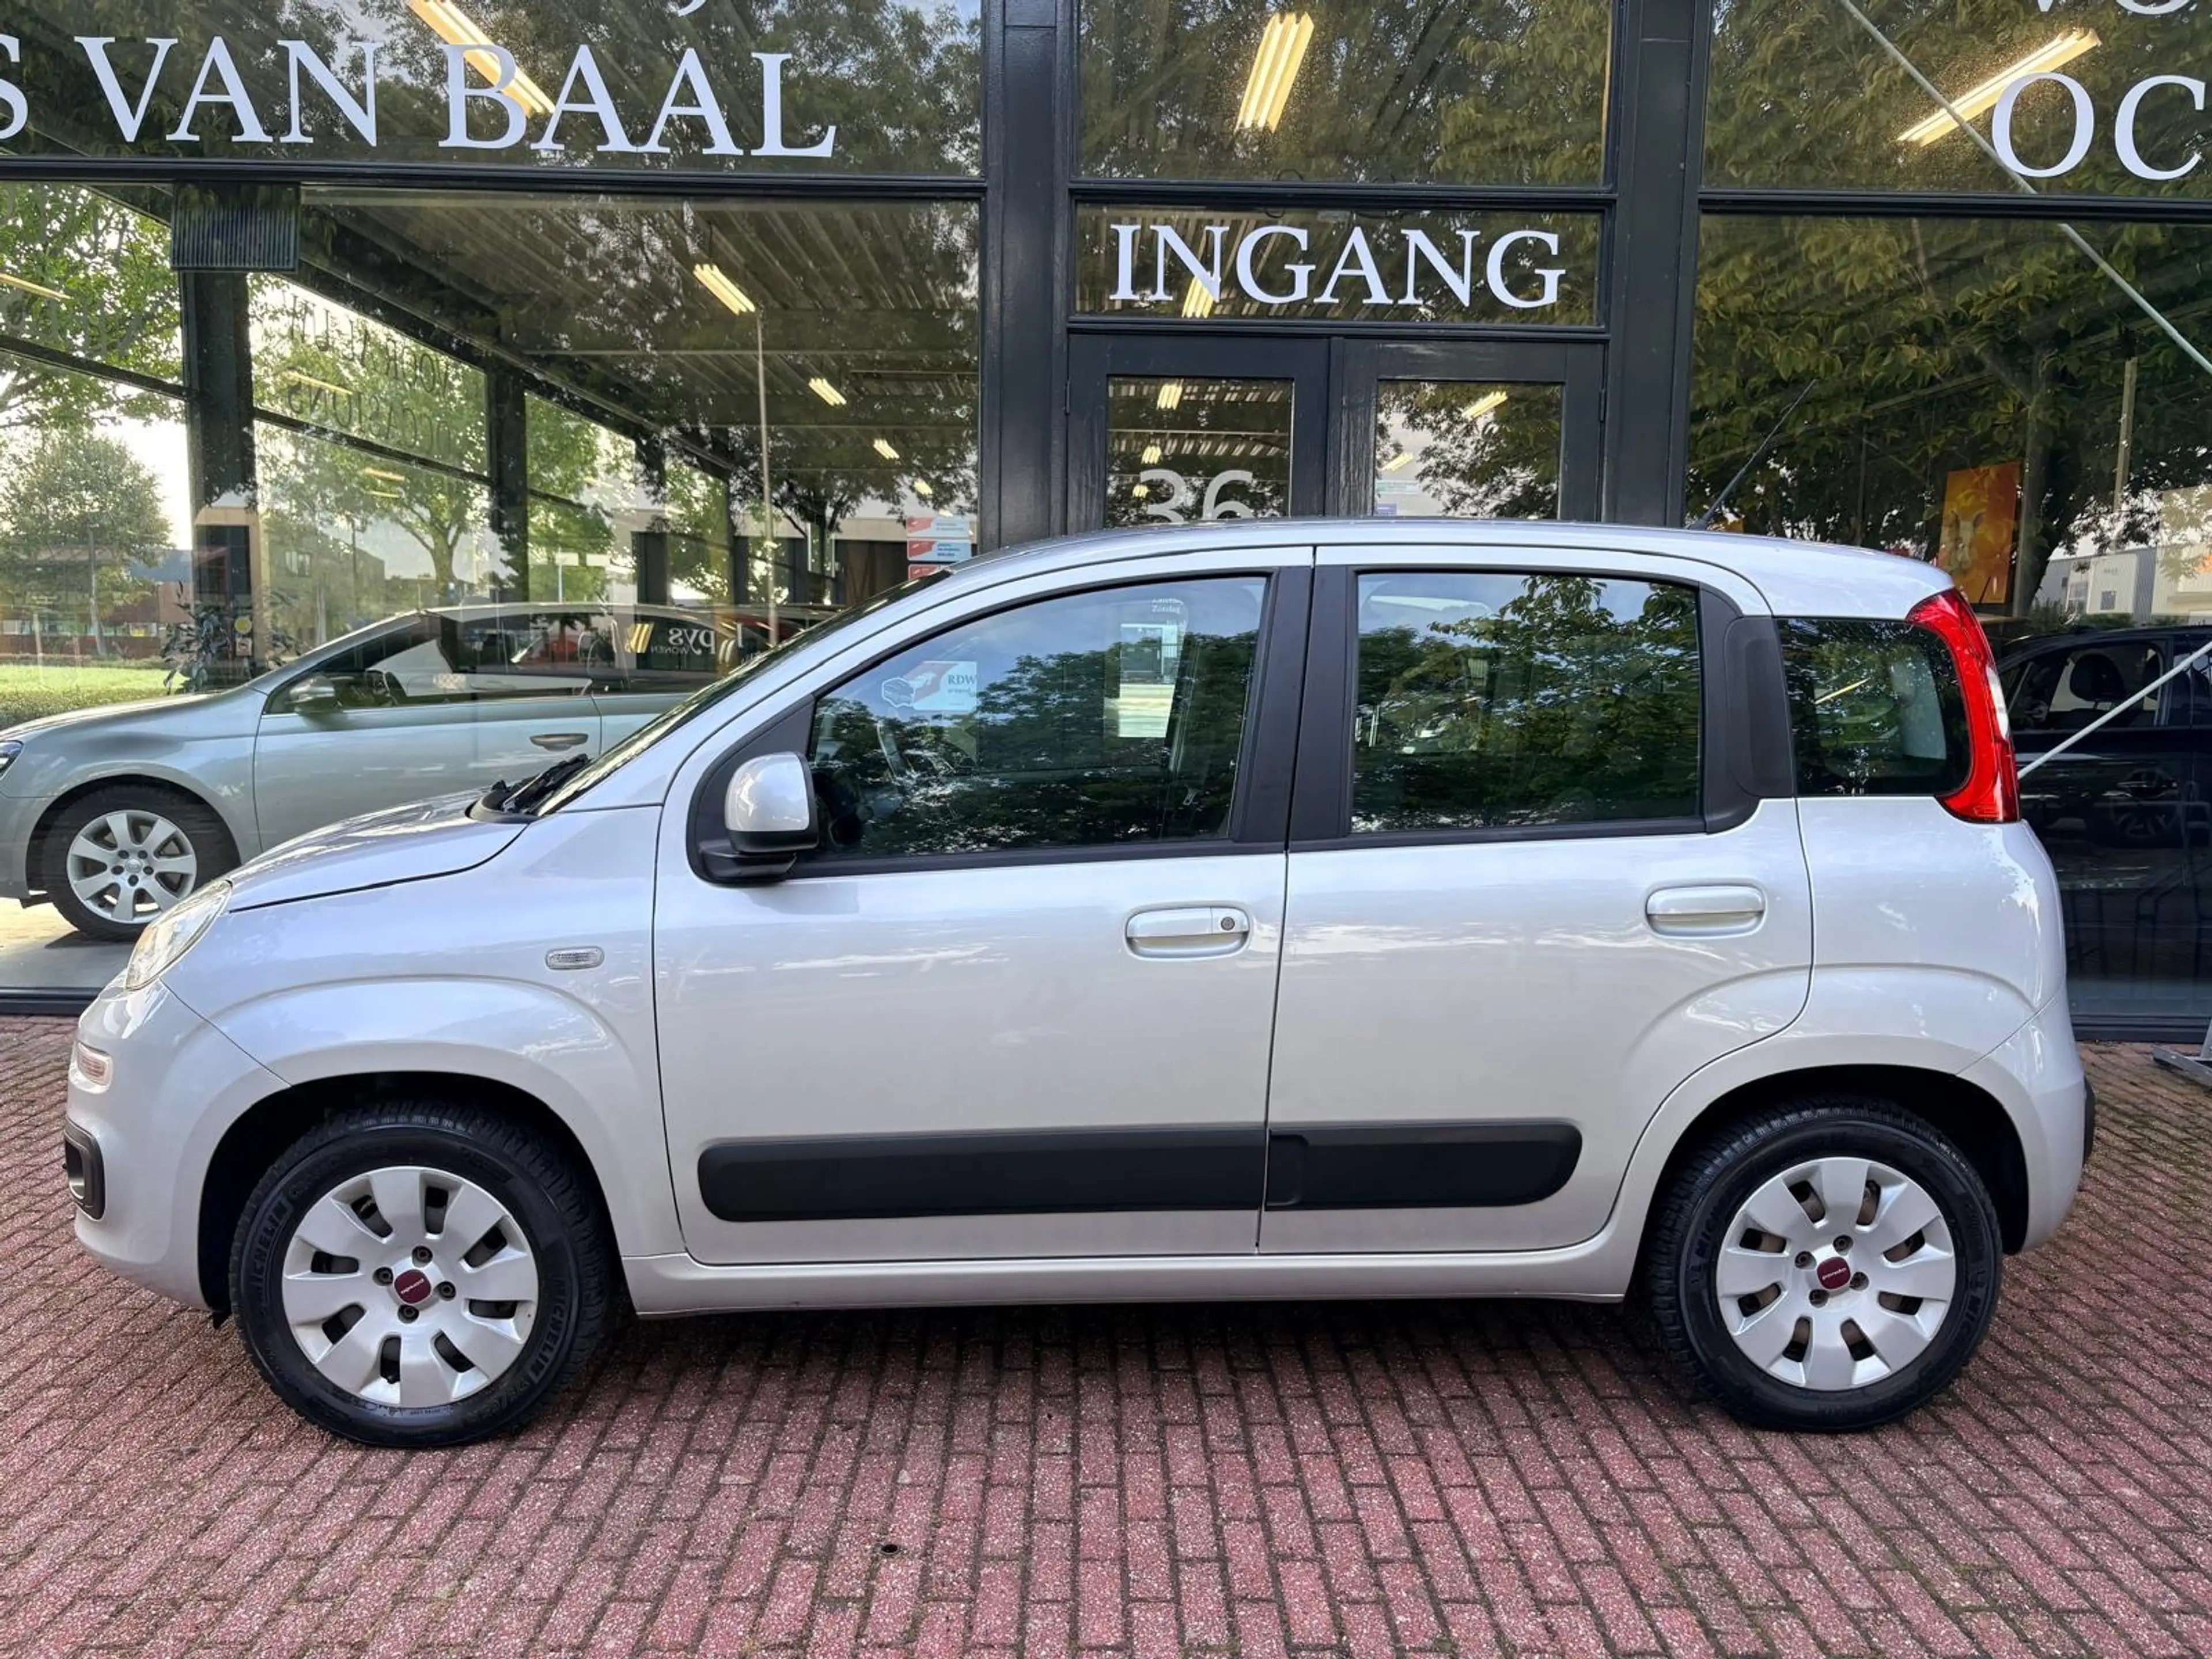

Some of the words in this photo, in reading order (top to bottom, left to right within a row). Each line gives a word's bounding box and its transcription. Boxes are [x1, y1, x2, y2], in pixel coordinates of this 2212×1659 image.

[74, 35, 380, 147] VAN
[438, 43, 836, 158] BAAL
[1991, 71, 2206, 180] OC
[1109, 224, 1567, 309] INGANG
[1140, 468, 1254, 523] 36
[948, 674, 978, 685] RDW
